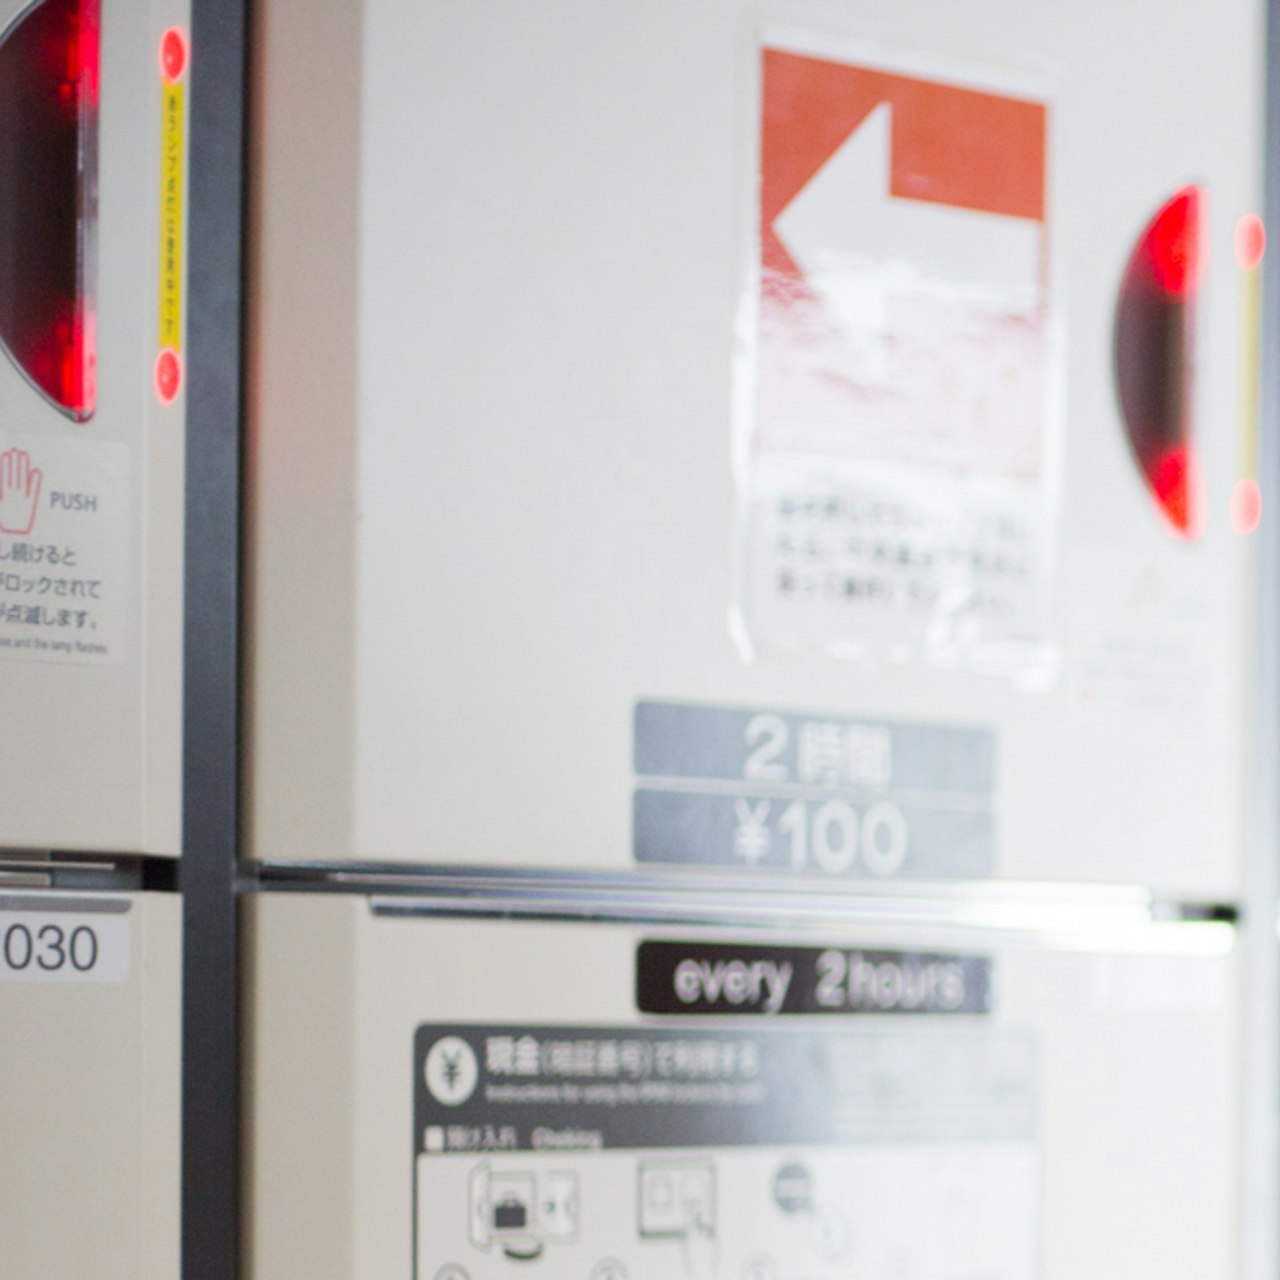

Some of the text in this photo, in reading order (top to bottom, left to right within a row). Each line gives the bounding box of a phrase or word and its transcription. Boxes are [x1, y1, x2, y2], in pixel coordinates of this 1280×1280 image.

[50, 490, 98, 512] PUSH
[733, 797, 908, 875] ¥100
[3, 922, 98, 972] 030
[673, 956, 794, 1015] every
